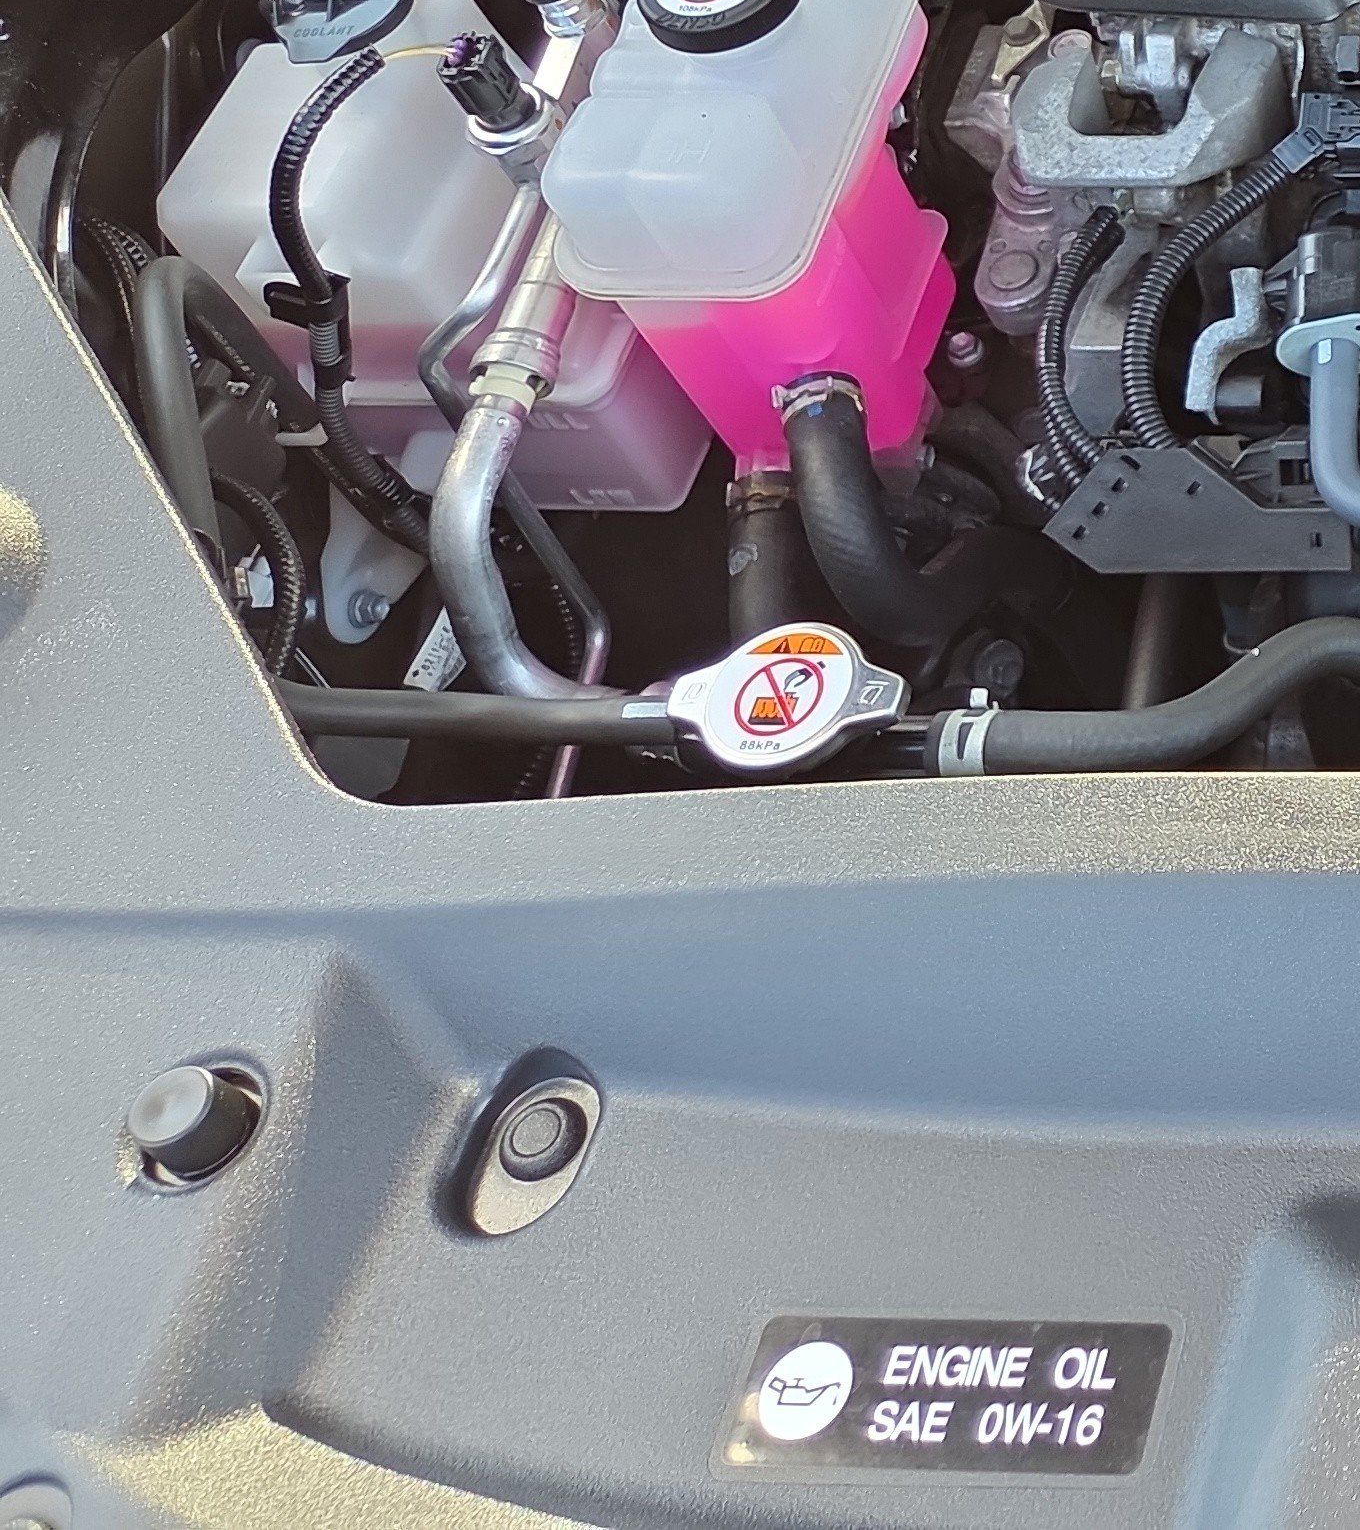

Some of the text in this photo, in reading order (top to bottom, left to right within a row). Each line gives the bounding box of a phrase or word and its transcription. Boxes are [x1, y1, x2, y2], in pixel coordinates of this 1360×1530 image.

[293, 25, 355, 38] COOLANT
[739, 740, 781, 751] 88kPa
[882, 1345, 1117, 1390] ENGINE OIL
[866, 1399, 1106, 1447] SAE 0W-16
